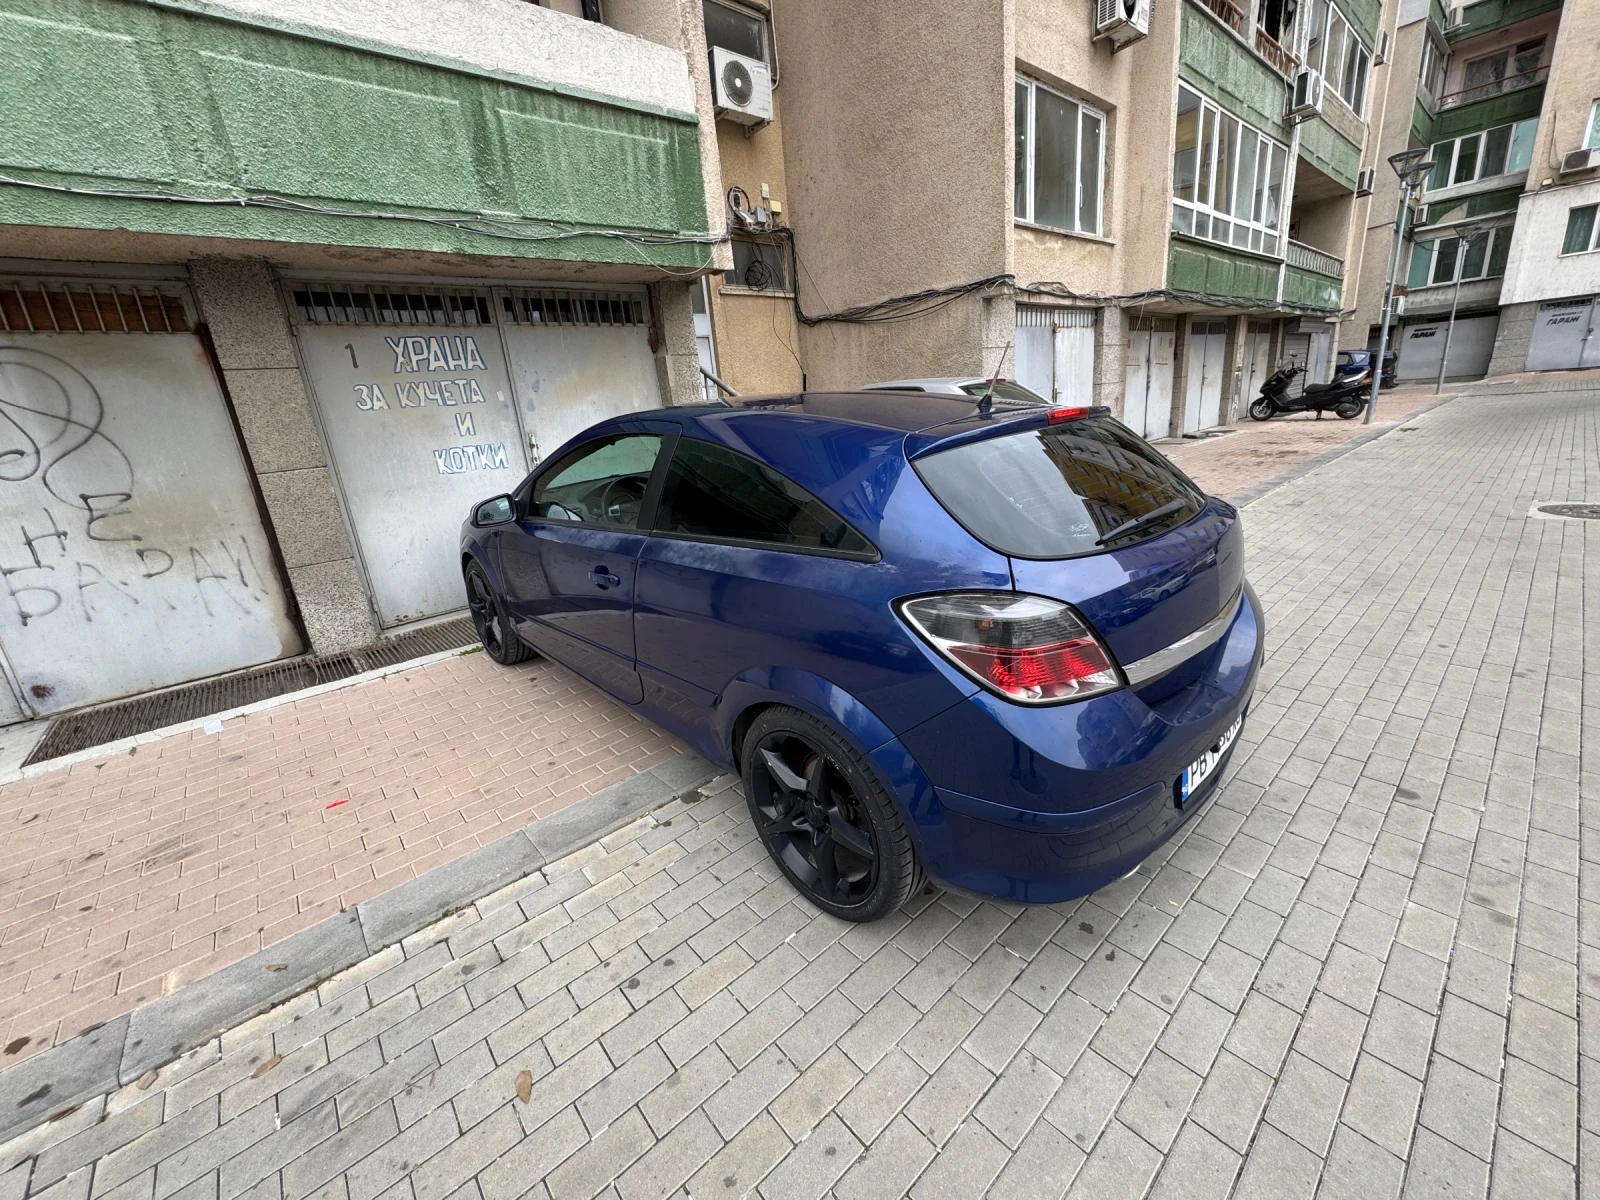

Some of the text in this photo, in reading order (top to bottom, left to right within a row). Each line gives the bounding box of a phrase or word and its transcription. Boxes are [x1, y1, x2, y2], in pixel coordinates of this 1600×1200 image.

[385, 335, 488, 373] ХРАНА
[353, 379, 486, 411] ЗА КУЧЕТА
[455, 412, 476, 437] И
[433, 443, 508, 474] КОТКИ
